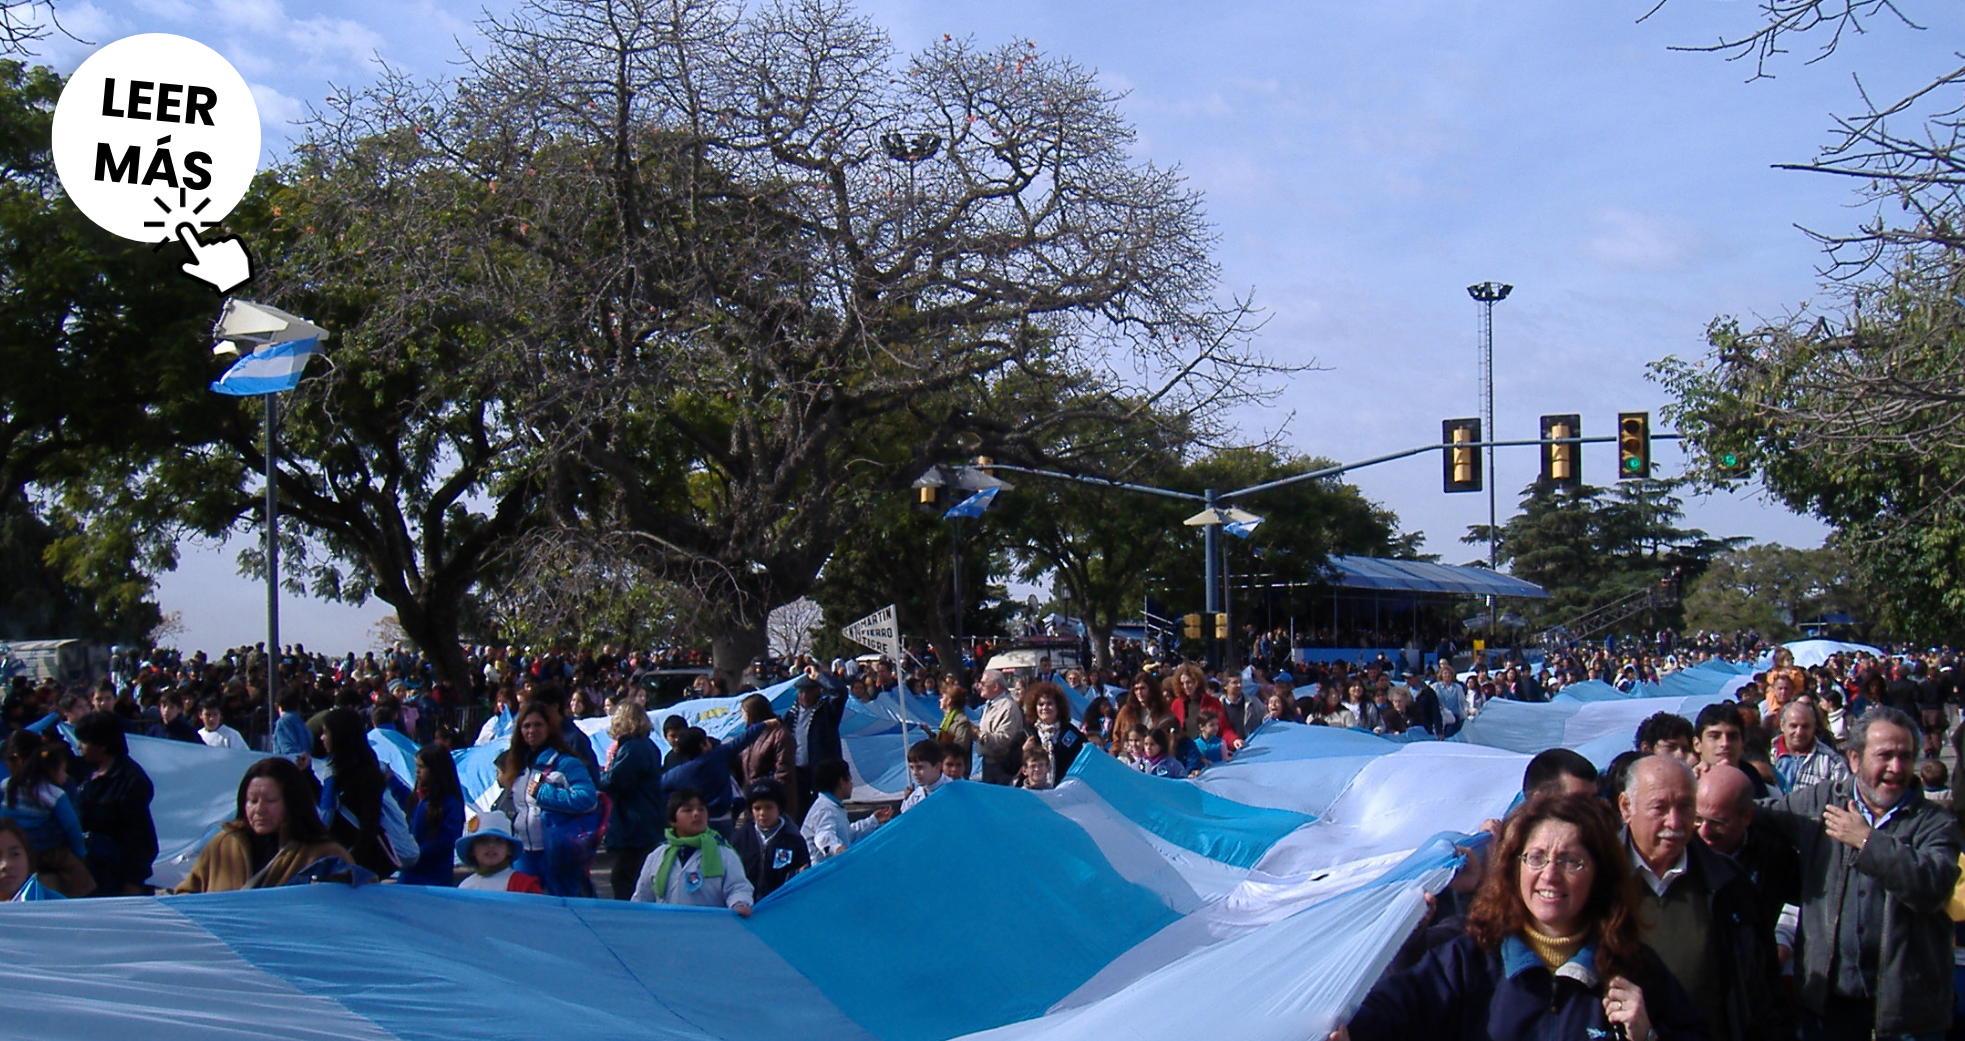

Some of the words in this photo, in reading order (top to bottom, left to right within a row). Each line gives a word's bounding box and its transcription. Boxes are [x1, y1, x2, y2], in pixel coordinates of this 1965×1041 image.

[860, 608, 892, 627] MARTIN
[861, 628, 893, 638] FIERRO
[862, 637, 888, 653] TIGRE
